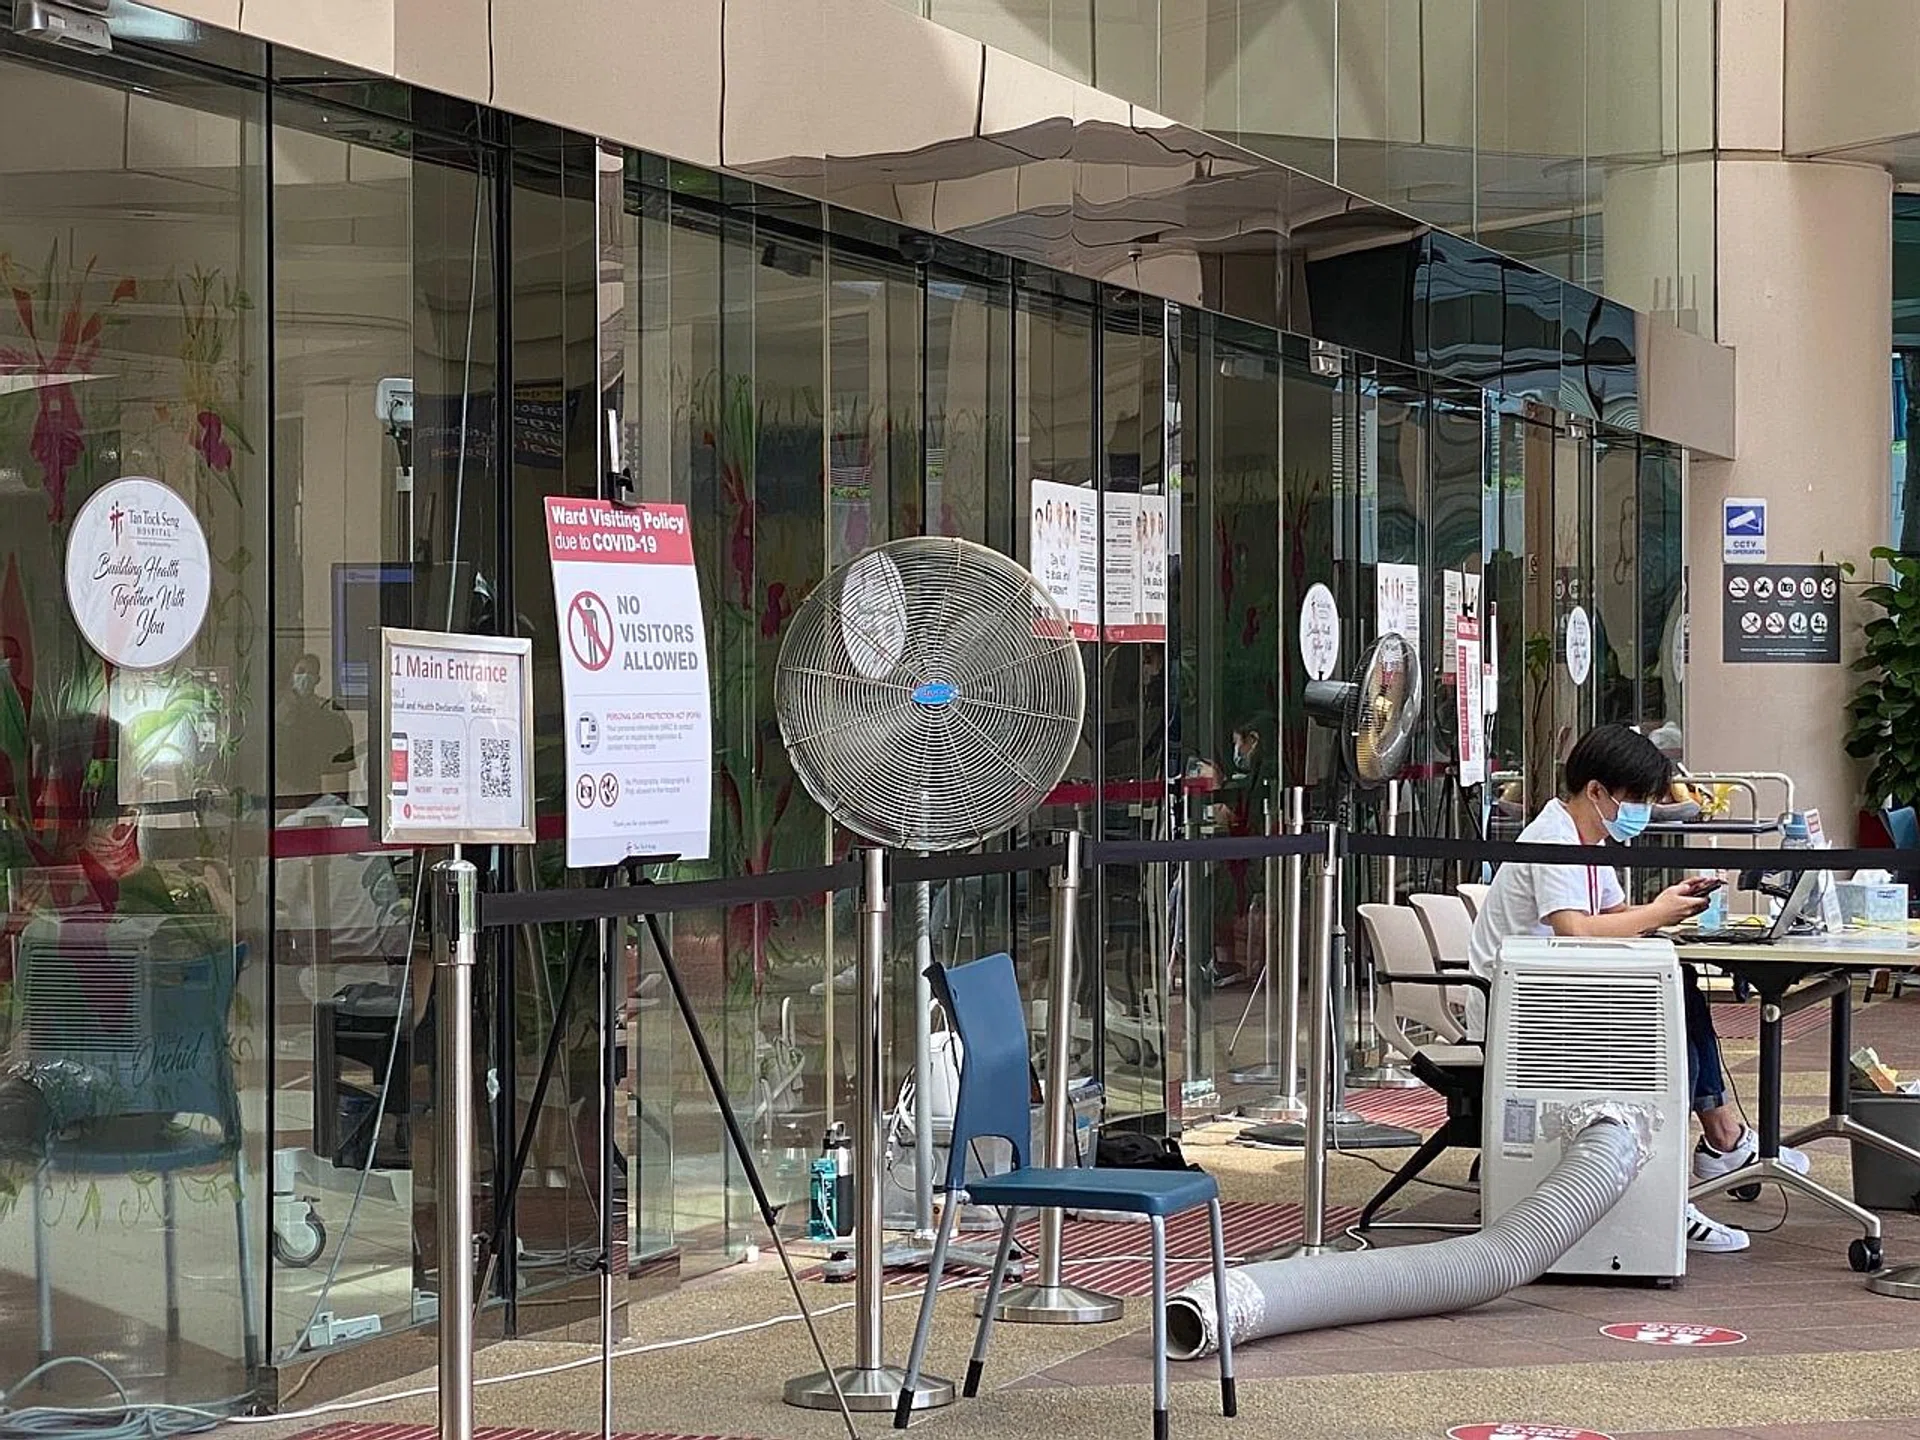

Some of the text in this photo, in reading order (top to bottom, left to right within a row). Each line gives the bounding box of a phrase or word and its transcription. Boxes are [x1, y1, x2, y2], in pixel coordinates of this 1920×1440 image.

[128, 509, 179, 530] Tan Tock Seng
[551, 506, 684, 534] Ward Visiting Policy
[555, 532, 657, 553] due to COVID-19
[1733, 540, 1757, 548] CCTV
[93, 552, 180, 588] Building Health
[111, 583, 185, 617] Together With
[616, 595, 640, 615] NO
[136, 608, 165, 647] You
[619, 623, 694, 643] VISITORS
[406, 655, 443, 679] Main
[447, 659, 507, 683] Entrance
[623, 651, 698, 671] ALLOWED
[131, 1032, 204, 1088] Orchid
